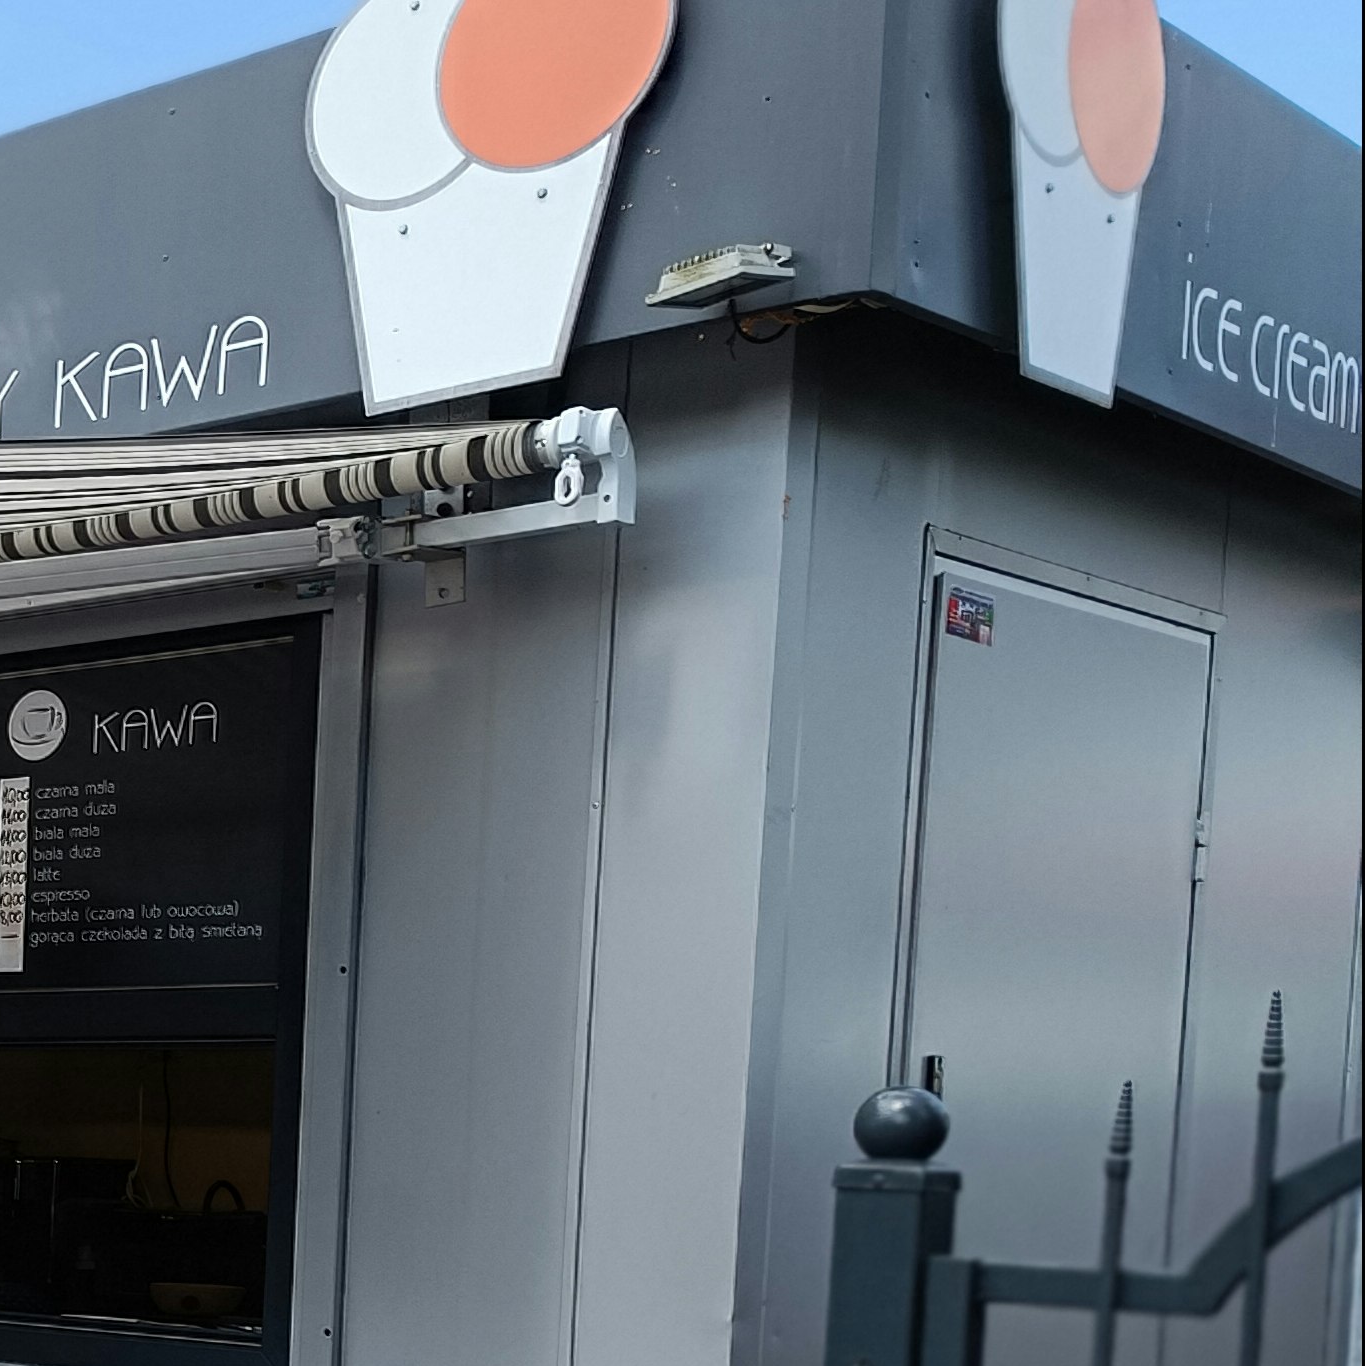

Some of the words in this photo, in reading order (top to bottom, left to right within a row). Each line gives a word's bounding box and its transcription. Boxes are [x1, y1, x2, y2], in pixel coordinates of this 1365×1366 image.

[55, 315, 269, 429] KAWA
[91, 701, 219, 754] KAWA
[32, 866, 61, 882] latte
[30, 889, 91, 906] espresso
[0, 911, 24, 926] 8,00
[30, 907, 80, 924] herbata
[140, 903, 162, 920] lub
[166, 899, 240, 919] owocowa)
[28, 929, 75, 949] gorąca
[81, 923, 148, 944] czekolada
[168, 923, 195, 943] bitą
